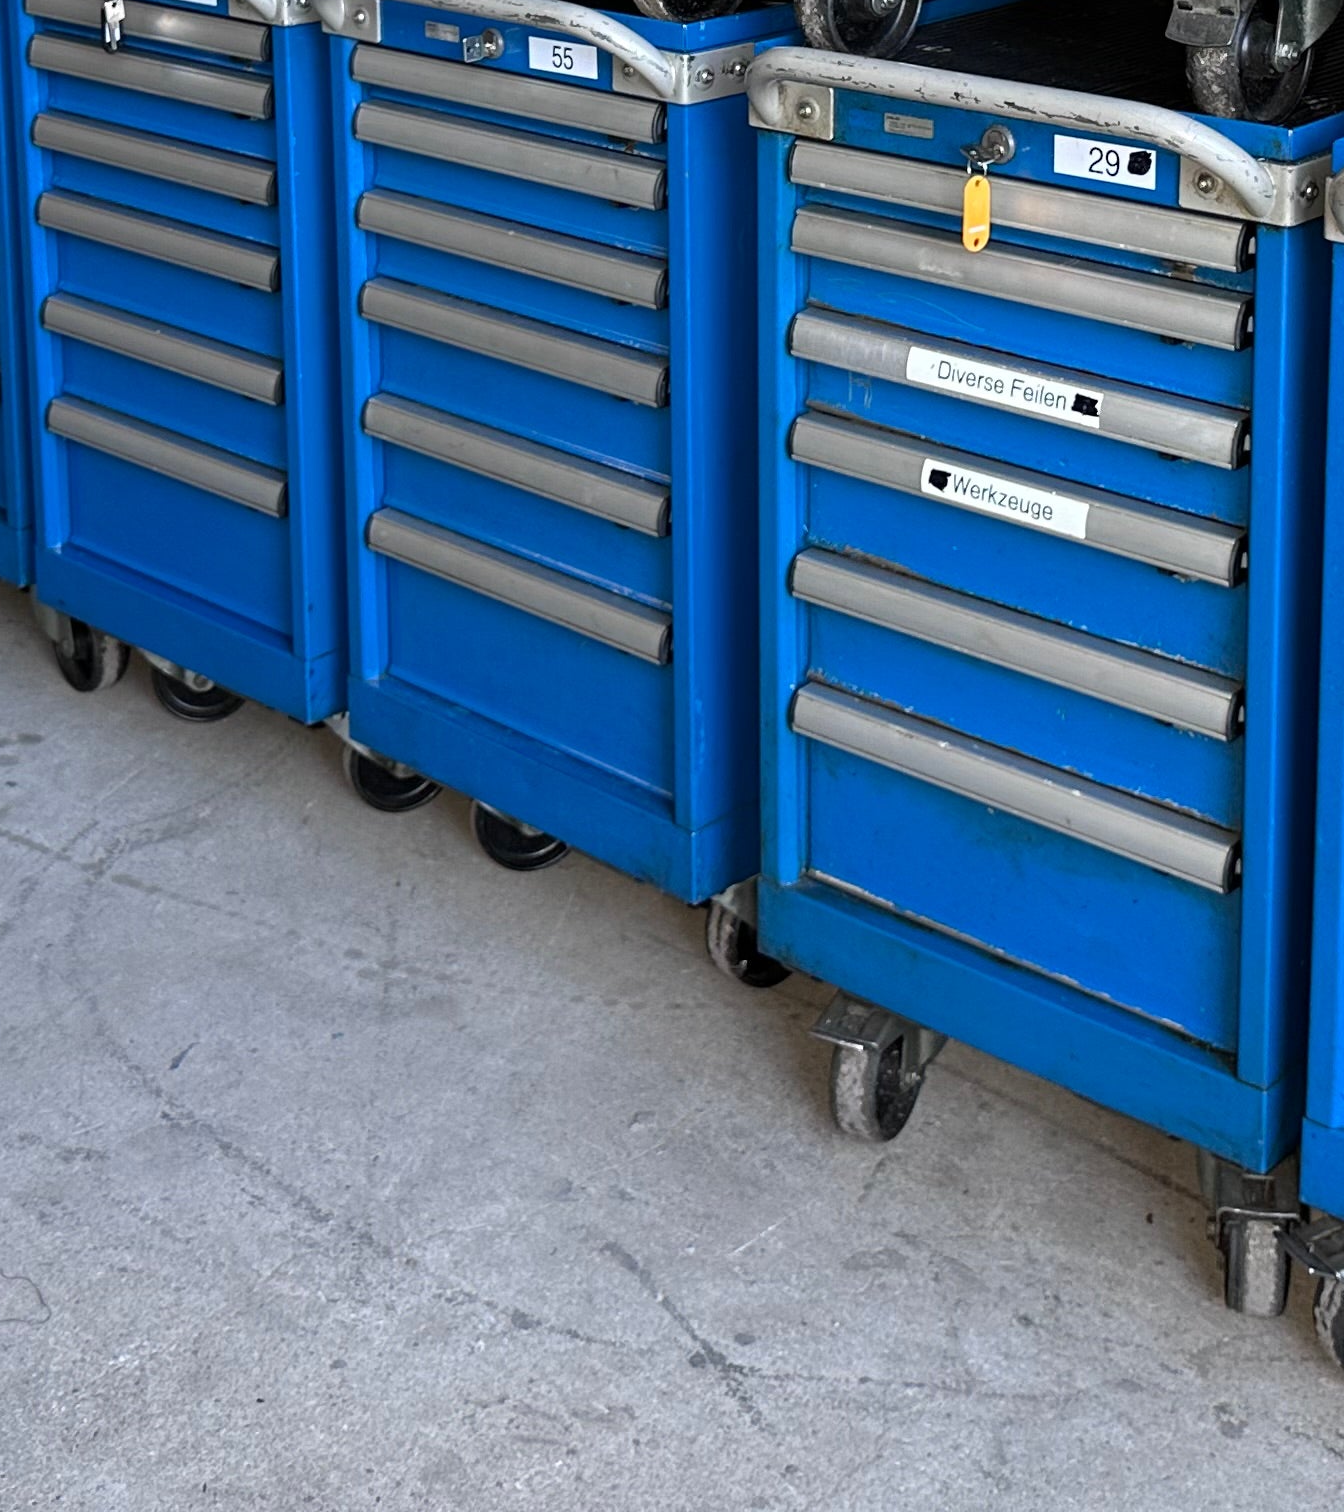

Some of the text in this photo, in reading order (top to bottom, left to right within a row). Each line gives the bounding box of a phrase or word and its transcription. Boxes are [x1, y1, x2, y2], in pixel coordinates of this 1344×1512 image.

[551, 46, 573, 71] 55
[1088, 146, 1120, 177] 29
[937, 360, 1068, 410] Diverse Feilen
[953, 472, 1054, 521] Werkzeuge
